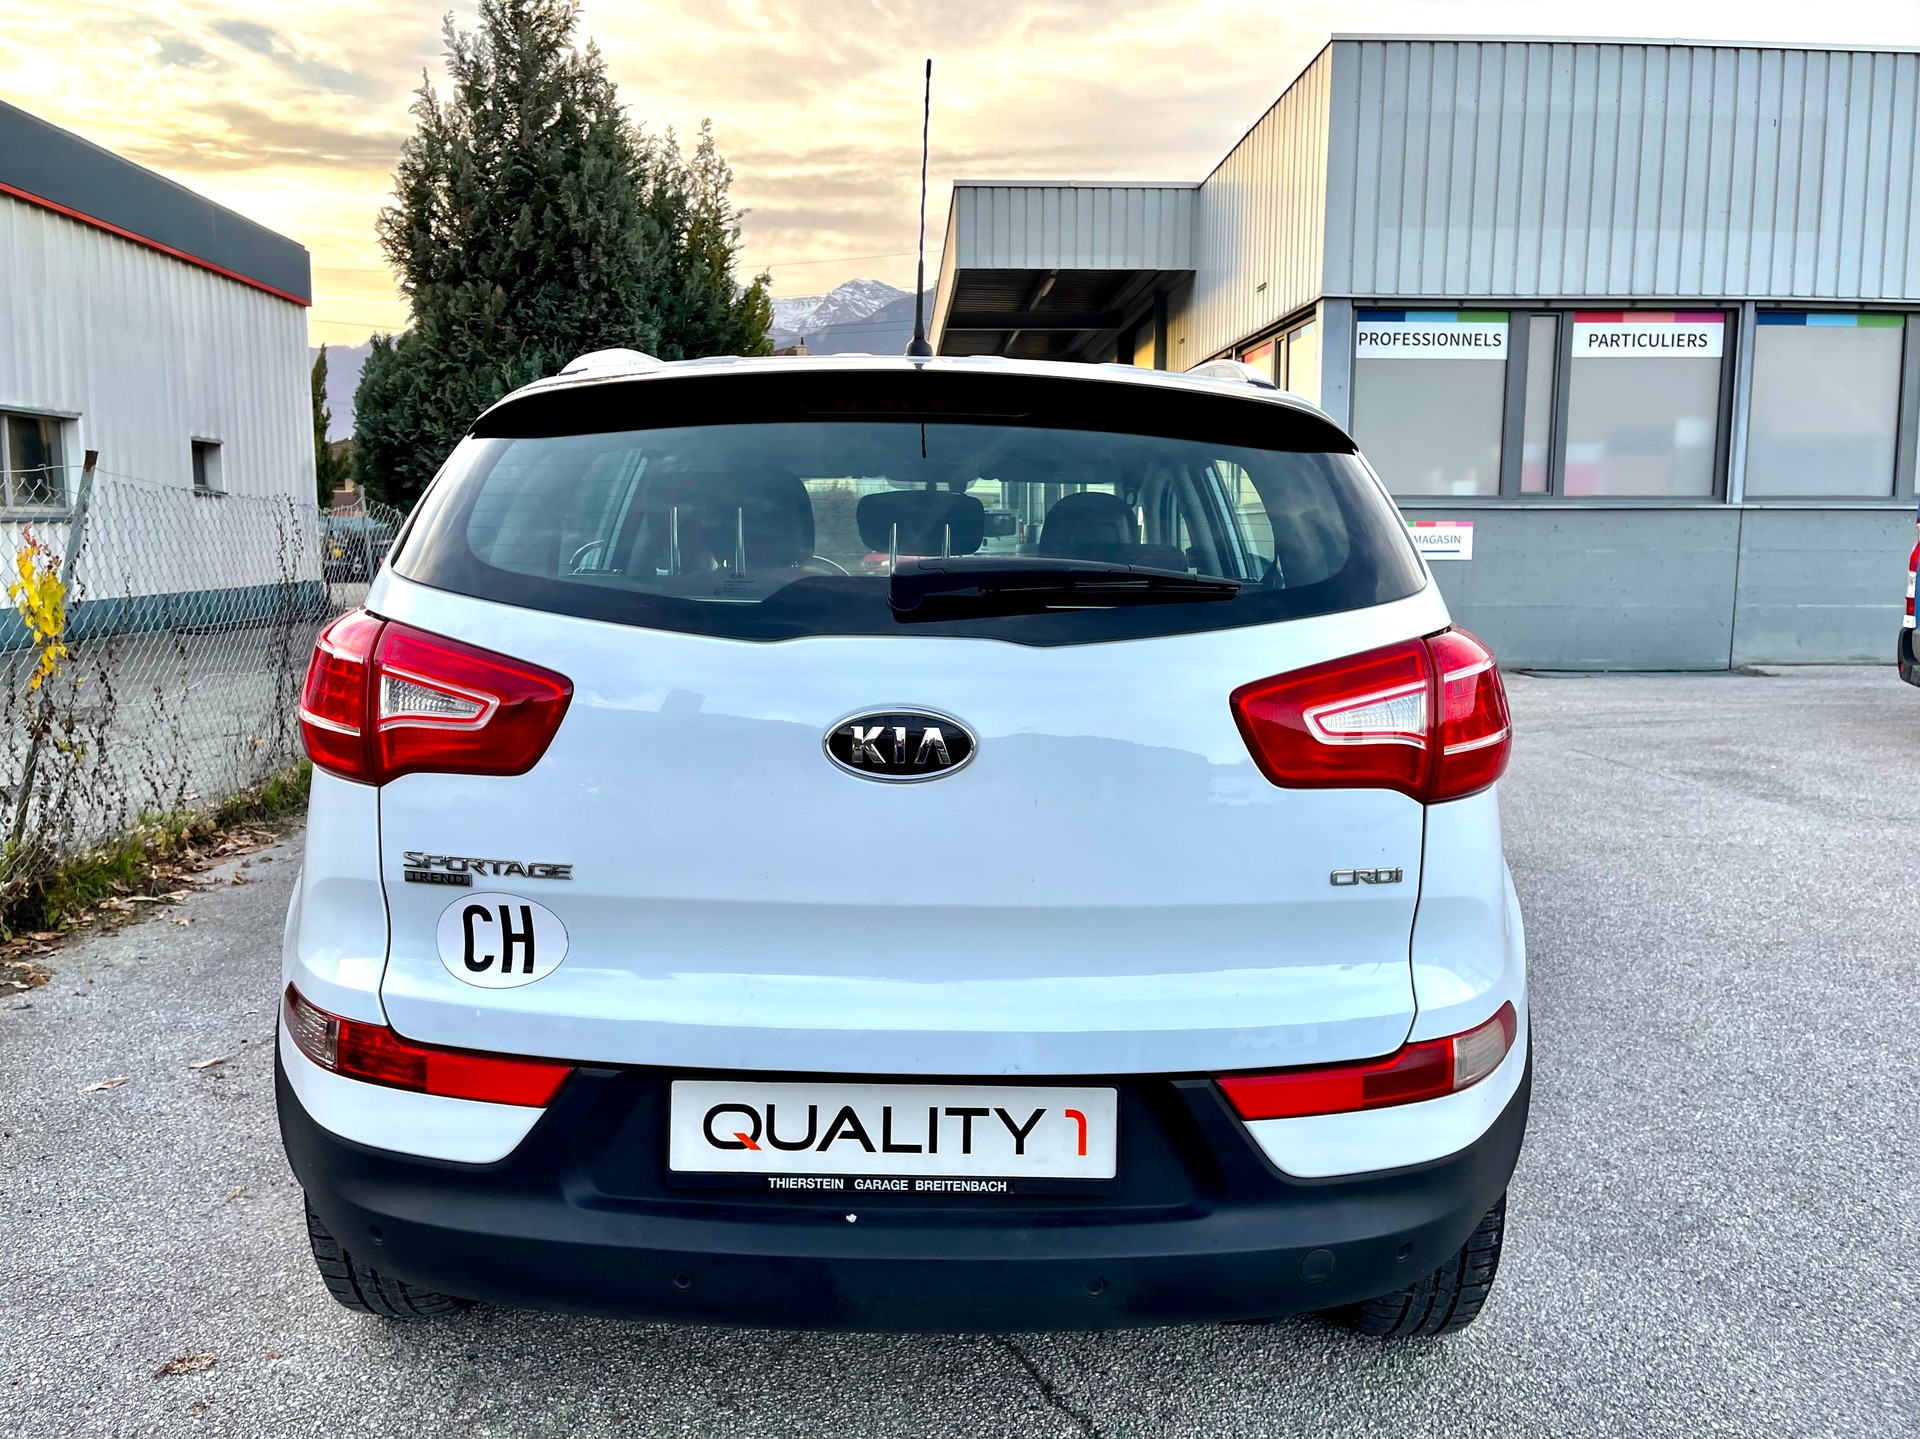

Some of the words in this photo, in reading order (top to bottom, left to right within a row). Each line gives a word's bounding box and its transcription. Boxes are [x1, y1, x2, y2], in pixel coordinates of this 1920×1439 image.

[1358, 331, 1502, 348] PROFESSIONNELS
[1588, 332, 1708, 349] PARTICULIERS
[1413, 534, 1461, 545] MAGASIN
[851, 726, 951, 764] KIA
[403, 851, 574, 880] SPORTAGE
[408, 870, 466, 886] TREND
[462, 904, 536, 974] CH
[702, 1103, 1047, 1155] QUALITY
[1065, 1108, 1088, 1156] 1
[768, 1177, 844, 1190] THIERSTEIN
[854, 1179, 909, 1191] GARAGE
[915, 1180, 1008, 1192] BREITENBACH
